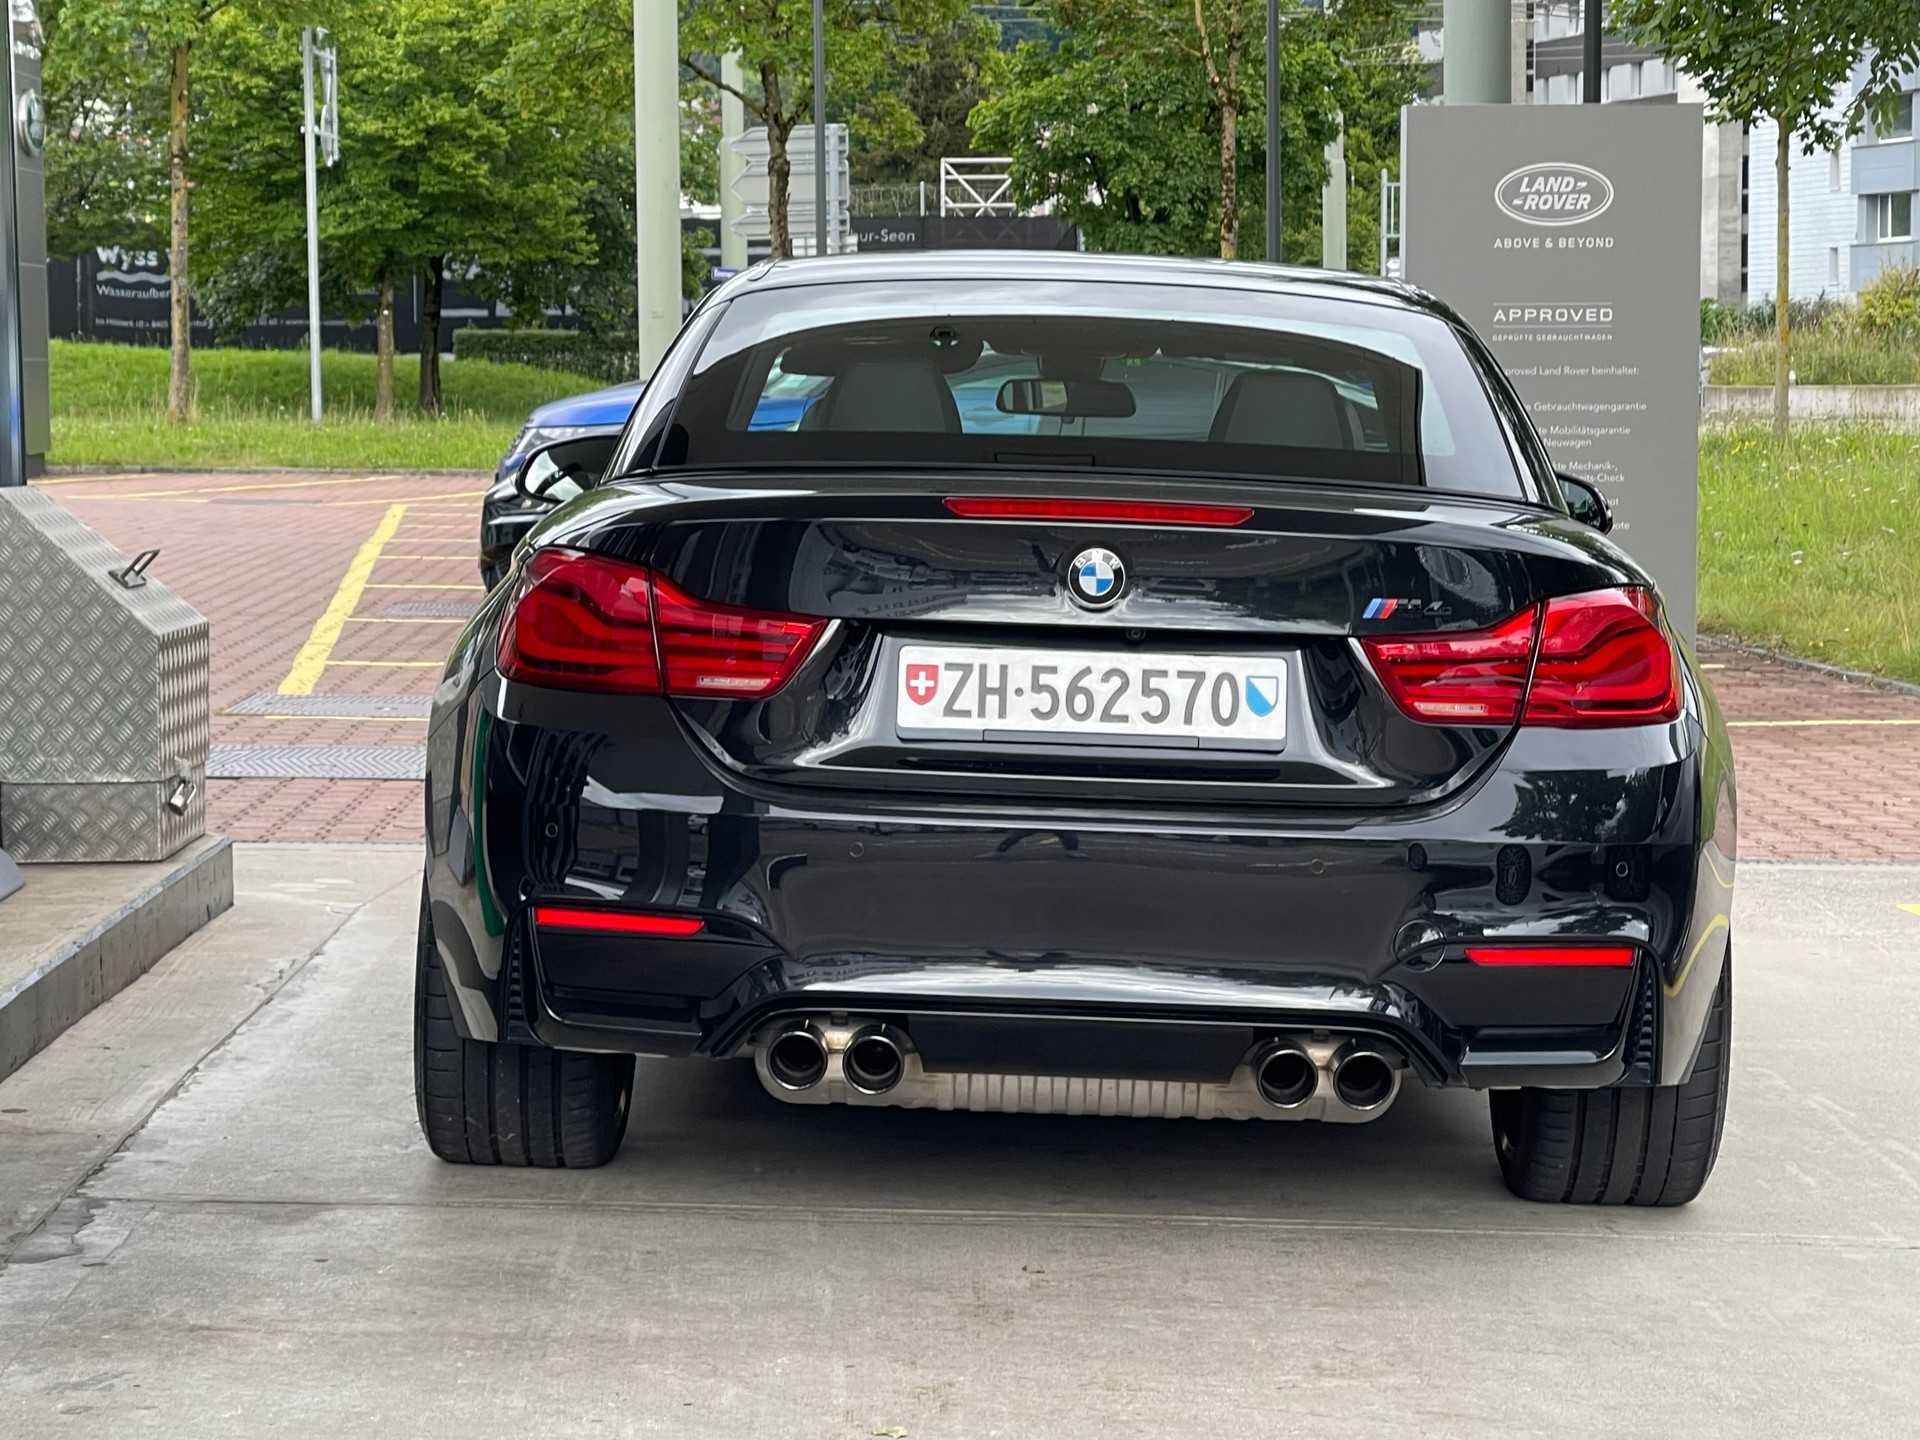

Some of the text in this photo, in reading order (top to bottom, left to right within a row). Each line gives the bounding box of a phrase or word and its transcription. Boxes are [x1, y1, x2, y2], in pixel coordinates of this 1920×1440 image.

[1519, 176, 1575, 193] LAND
[1523, 194, 1592, 210] ROVER
[859, 228, 916, 243] ur-Seen
[1493, 237, 1614, 249] ABOVE & BEYOND
[96, 245, 158, 271] Wyss
[96, 284, 171, 299] Wasseraufber
[1493, 308, 1613, 323] APPROVED
[1536, 333, 1613, 341] GEBRAUCHTWAGEN
[1504, 365, 1640, 377] proved Land Rover beinhaltet:
[1533, 401, 1647, 413] Gebrauchtwagengarantie
[1550, 425, 1631, 437] Mobilitätsgarantie
[1543, 438, 1592, 449] Neuwagen
[1074, 550, 1121, 570] BMW
